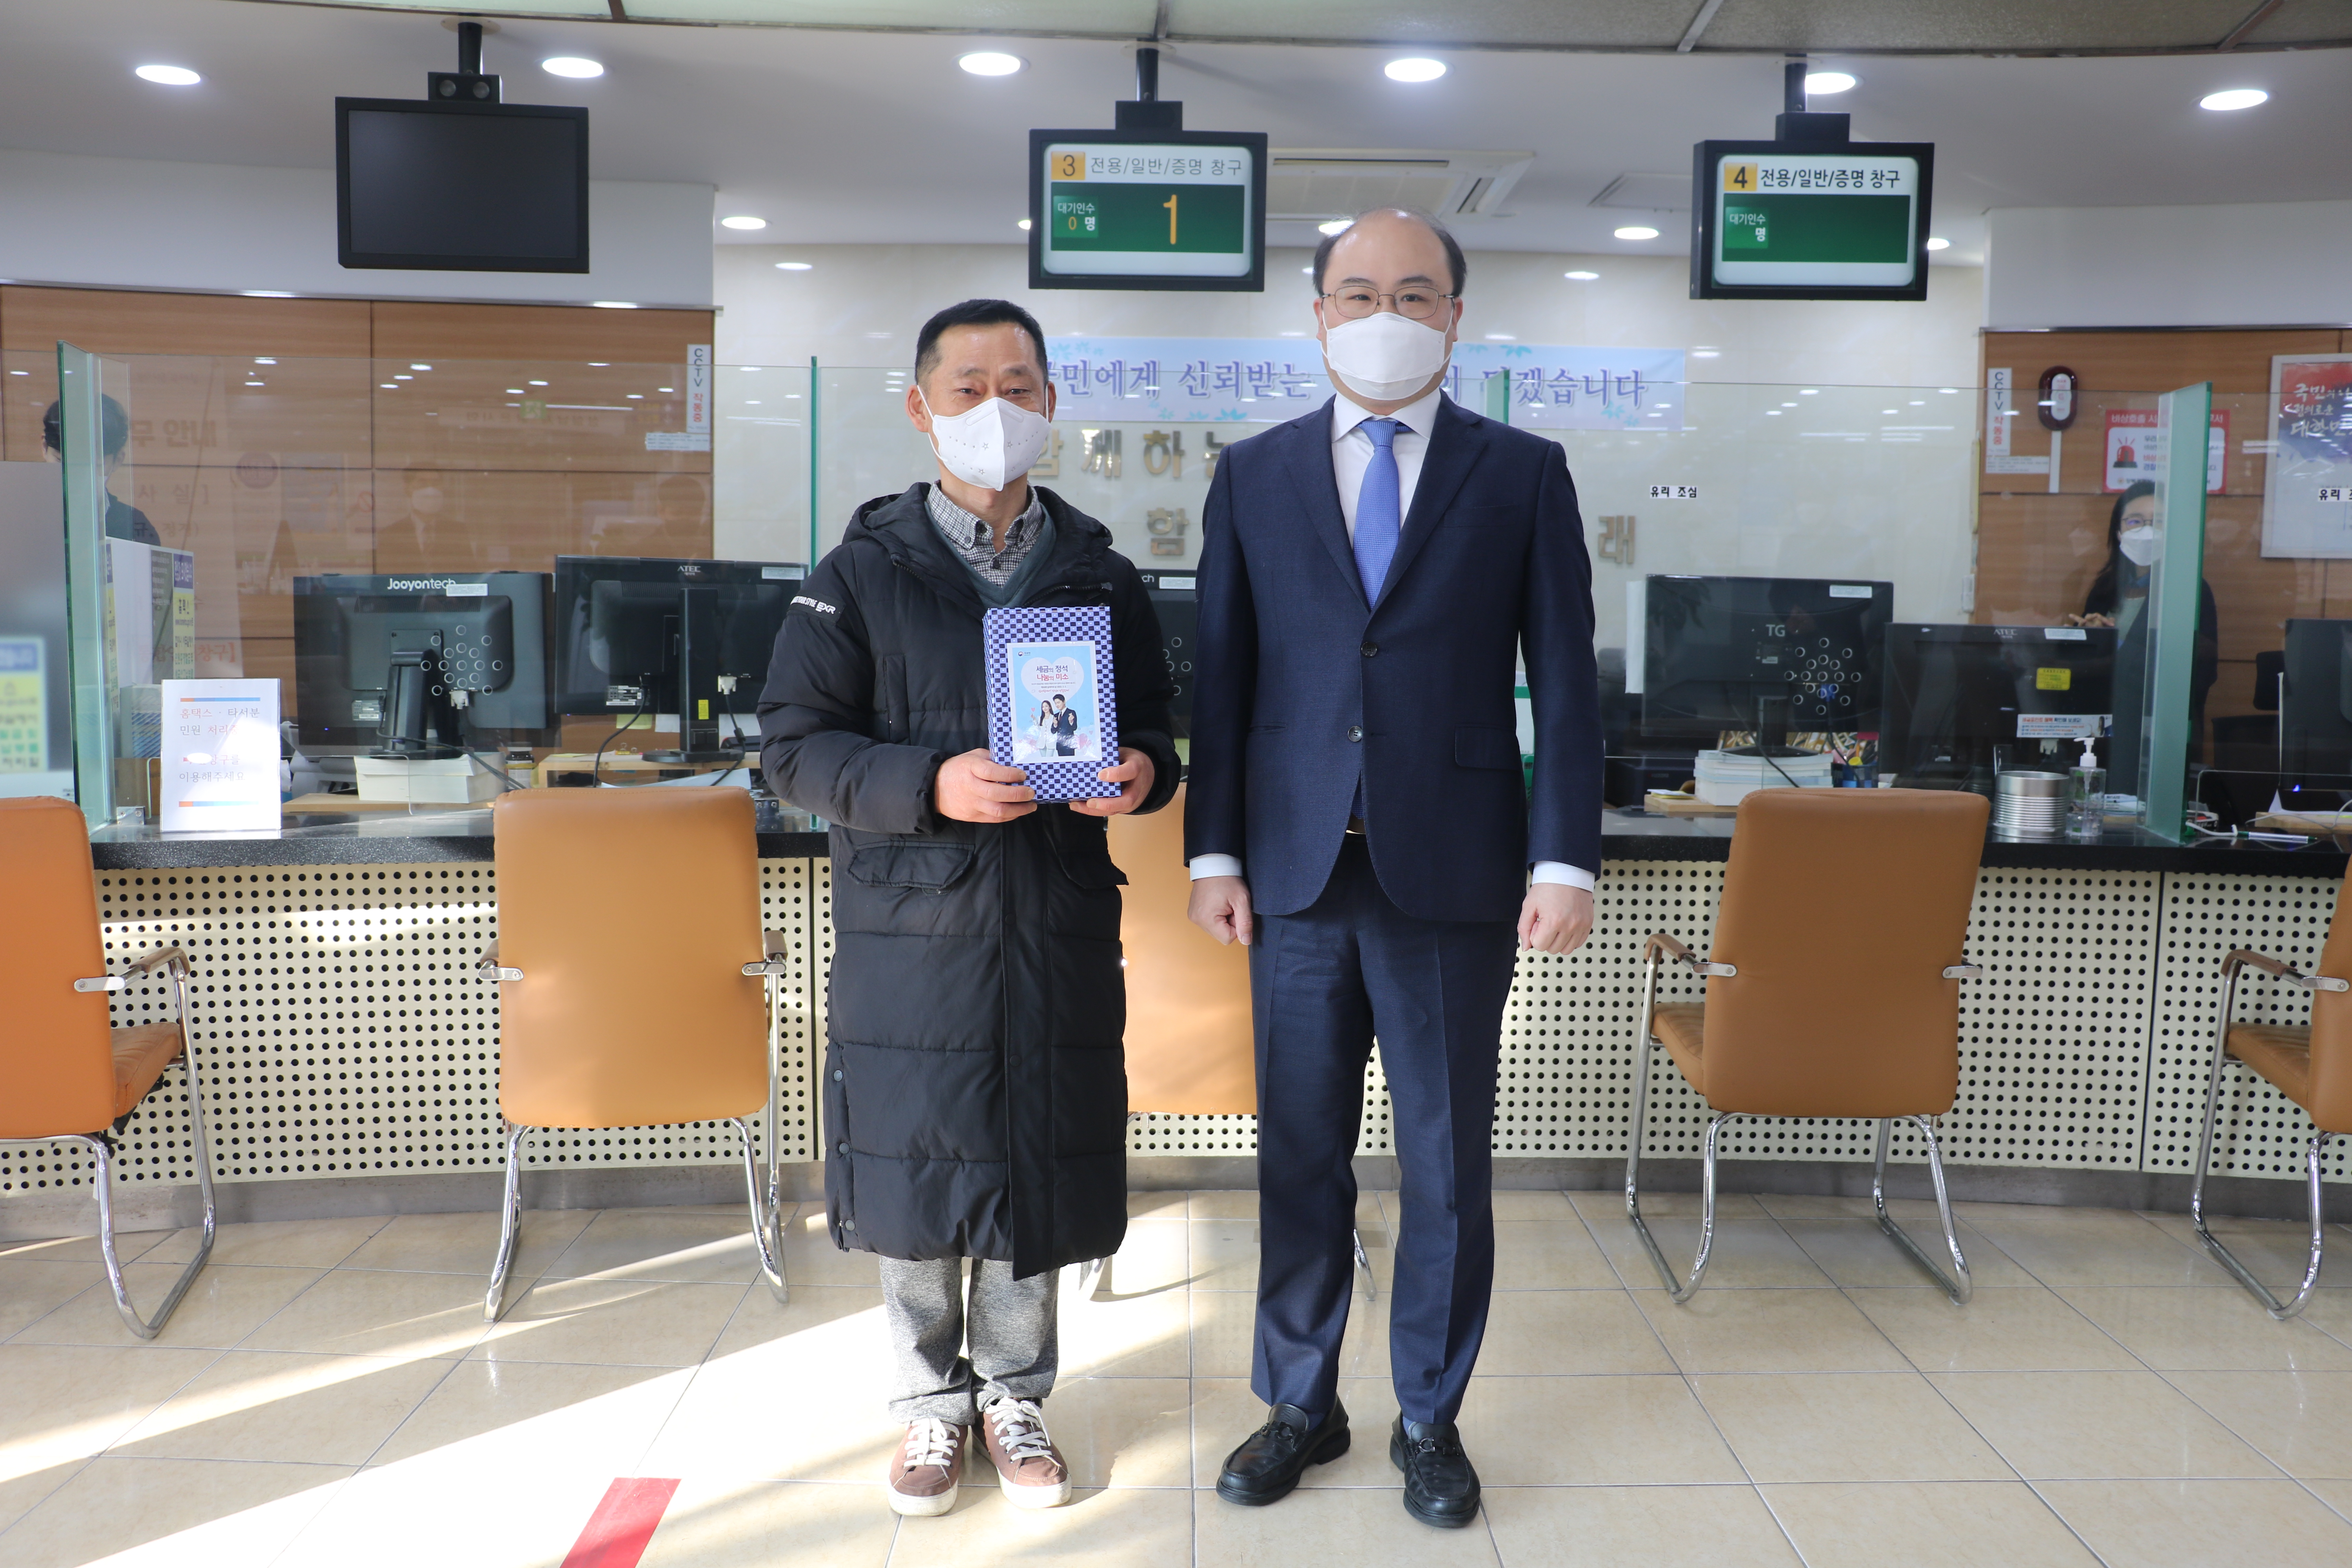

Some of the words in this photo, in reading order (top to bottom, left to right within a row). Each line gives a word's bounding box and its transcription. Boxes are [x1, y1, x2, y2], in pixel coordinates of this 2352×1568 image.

[1063, 154, 1075, 176] 3
[1091, 157, 1202, 175] 전용/일반/증명
[1210, 158, 1241, 176] 창구
[1734, 166, 1747, 188] 4
[1761, 169, 1864, 188] 전용/일반/증명
[1871, 170, 1900, 189] 창구
[1058, 203, 1095, 214] 대기인수
[1069, 216, 1076, 230] 0
[1084, 216, 1095, 231] 명
[1163, 194, 1177, 245] 1
[1730, 213, 1766, 225] 대기인수
[1755, 227, 1766, 242] 명
[694, 348, 702, 387] CCTV
[1178, 360, 1313, 399] 신뢰받는
[1995, 372, 2004, 410] CCTV
[1650, 486, 1670, 498] 유리
[1677, 486, 1697, 498] 조심
[2319, 489, 2340, 501] 유리
[805, 597, 818, 608] STYLE
[815, 601, 836, 614] EXR
[1765, 624, 1786, 637] TG
[180, 708, 212, 719] 홈택스
[228, 708, 260, 718] 타서분
[180, 725, 201, 736] 민원
[179, 771, 245, 783] 이용해주세요
